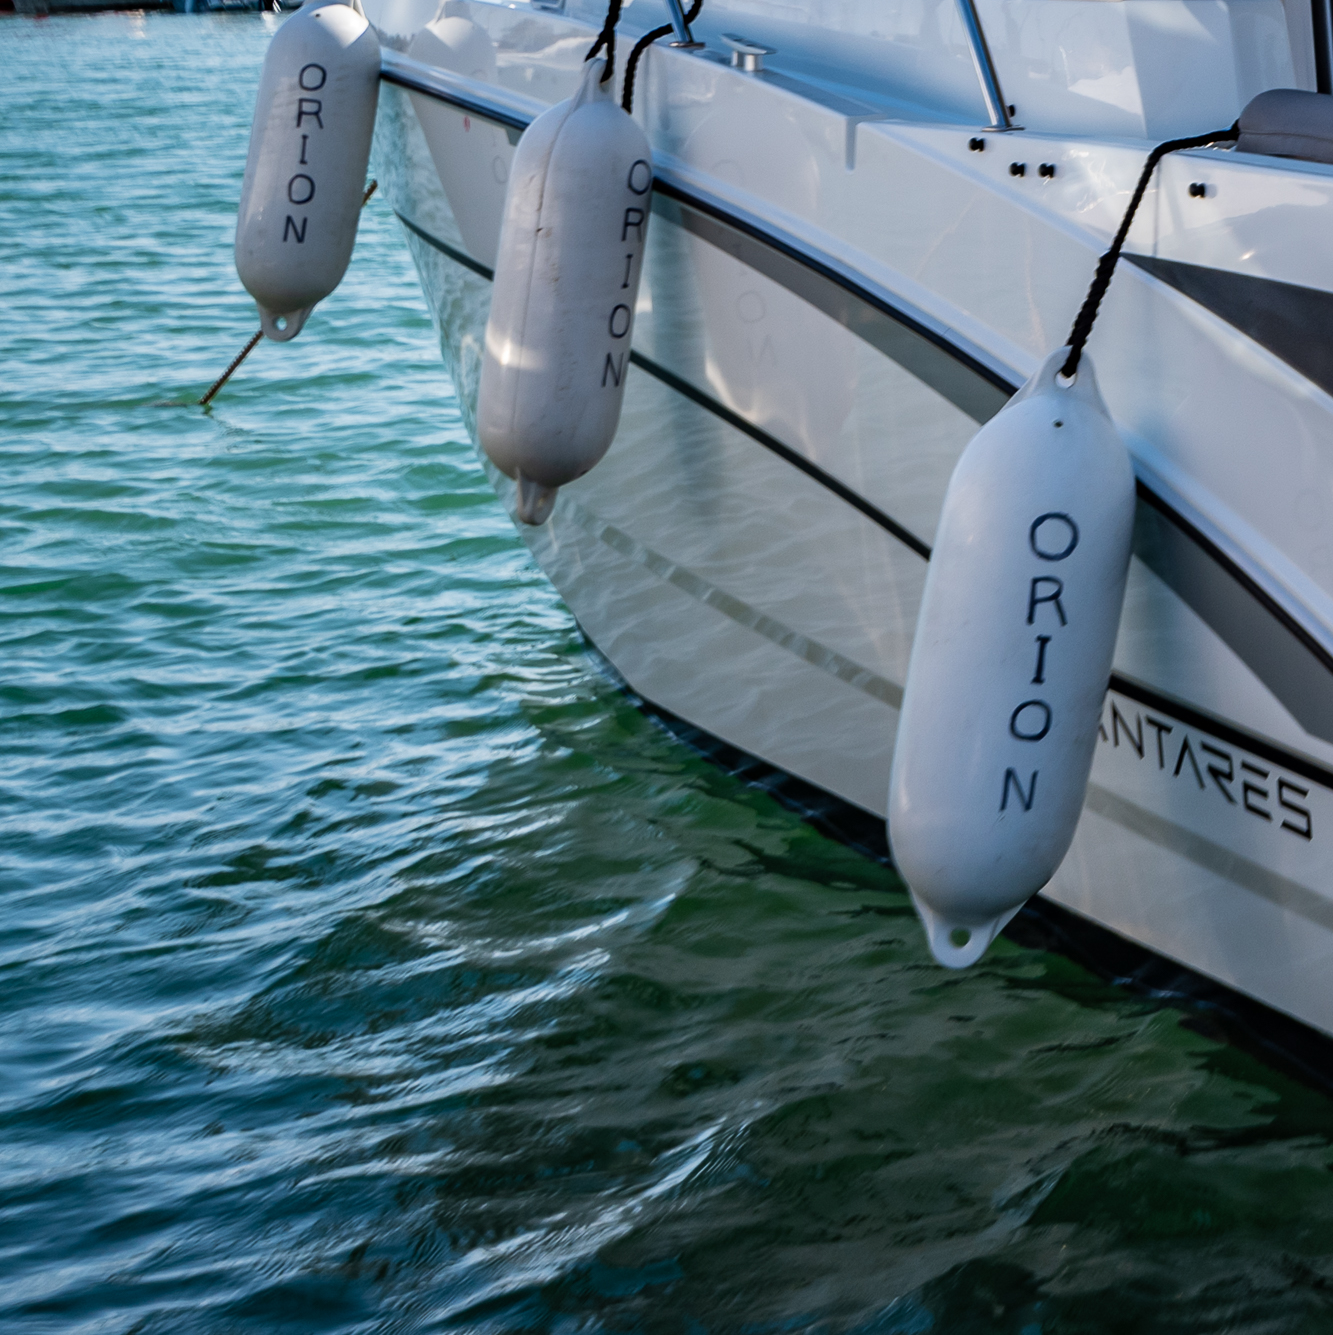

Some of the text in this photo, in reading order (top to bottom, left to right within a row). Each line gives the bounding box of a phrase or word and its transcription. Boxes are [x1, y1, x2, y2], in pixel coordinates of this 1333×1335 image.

[282, 62, 328, 245] ORION
[601, 159, 651, 388] ORION
[999, 512, 1080, 812] ORION
